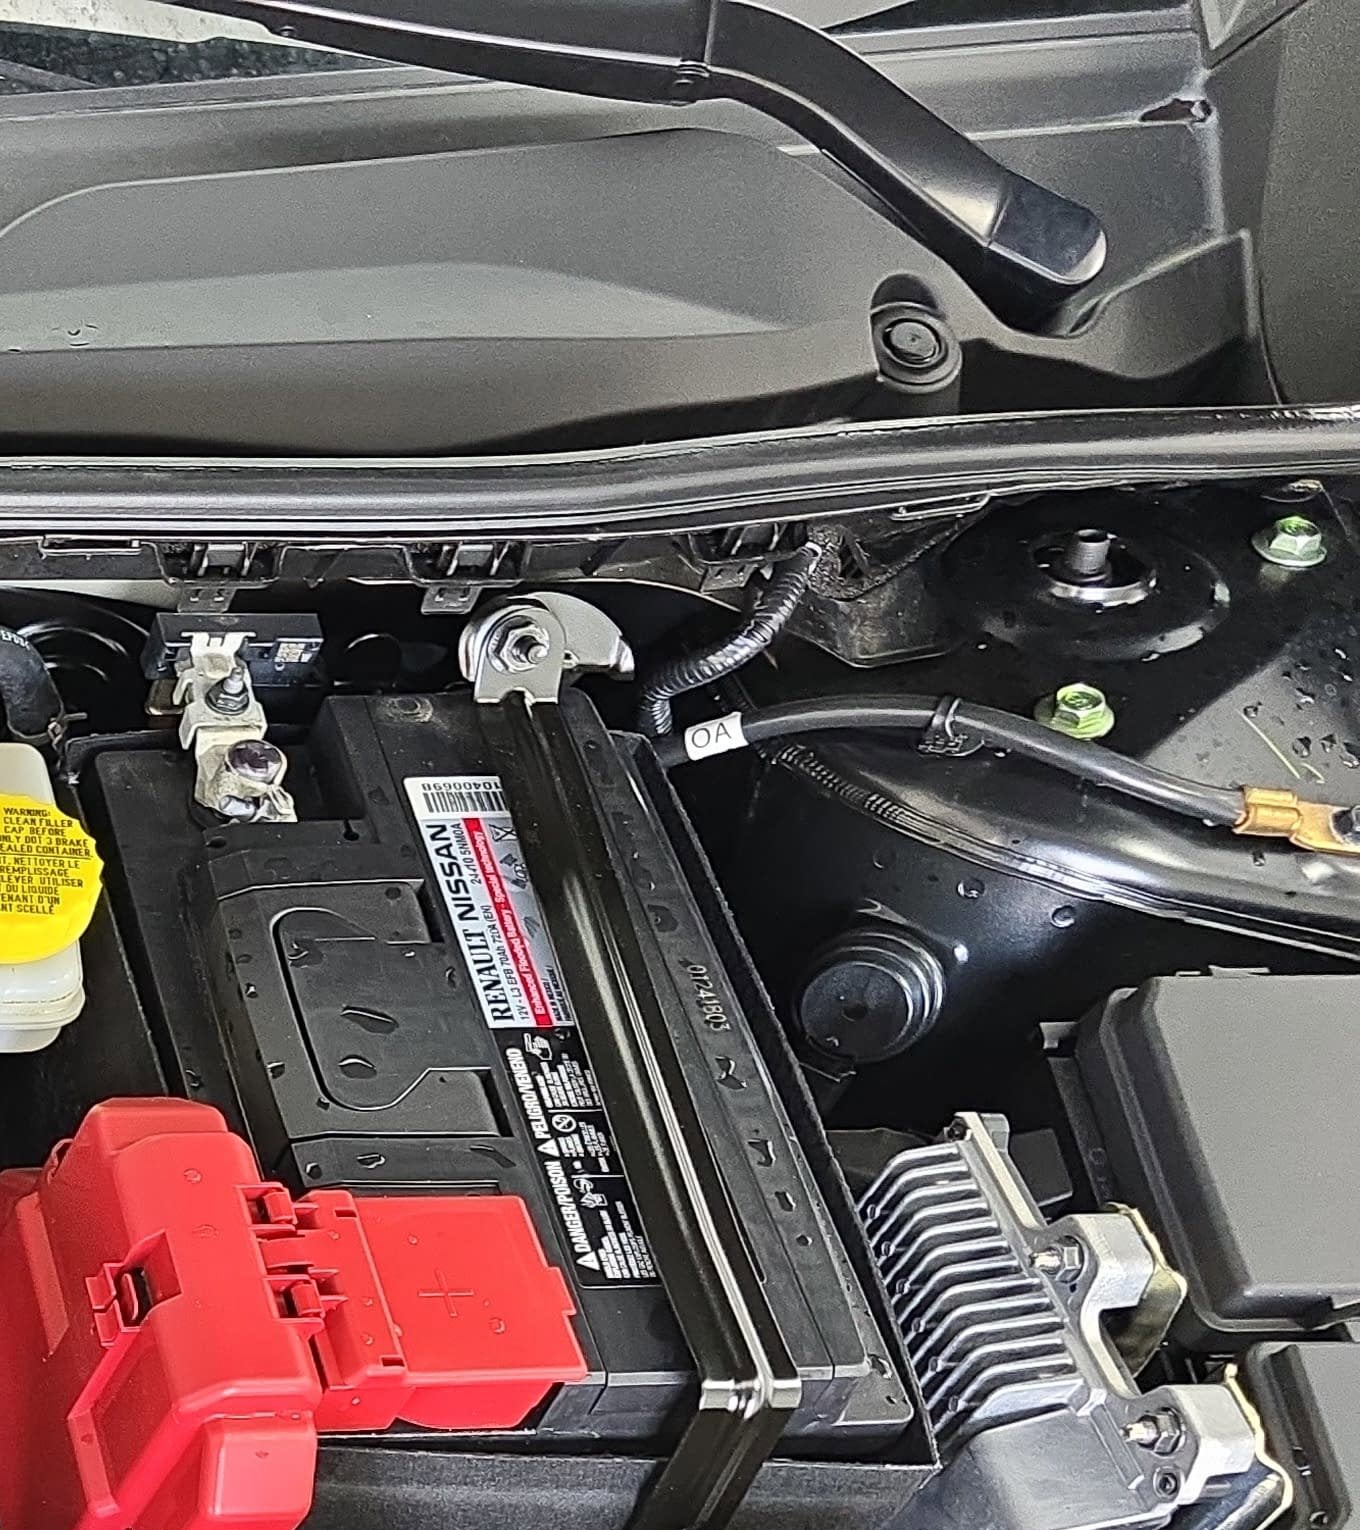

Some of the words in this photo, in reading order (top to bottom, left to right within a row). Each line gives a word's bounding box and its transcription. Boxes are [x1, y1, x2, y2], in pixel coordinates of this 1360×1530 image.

[3, 807, 51, 817] WARNING:
[3, 817, 36, 827] CLEAN
[39, 818, 73, 828] FILLER
[4, 826, 24, 834] CAP
[29, 827, 66, 836] BEFORE
[24, 835, 43, 844] DOT
[45, 836, 52, 845] 3
[55, 837, 88, 848] BRAKE
[472, 831, 494, 876] technology
[13, 857, 65, 868] NETTOYER
[68, 860, 80, 869] LE
[0, 865, 70, 877] REMPLISSAGE
[425, 823, 479, 922] NISSAN
[39, 877, 84, 888] UTILISER
[486, 874, 506, 903] Special
[5, 884, 19, 893] DU
[21, 885, 59, 896] LIQUIDE
[16, 904, 55, 915] SCELLÉ
[500, 909, 519, 938] Battery
[510, 938, 530, 972] Flooded
[462, 929, 515, 1022] RENAULT
[521, 973, 546, 1016] Enhanced
[544, 1161, 592, 1254] DANGER/POISON
